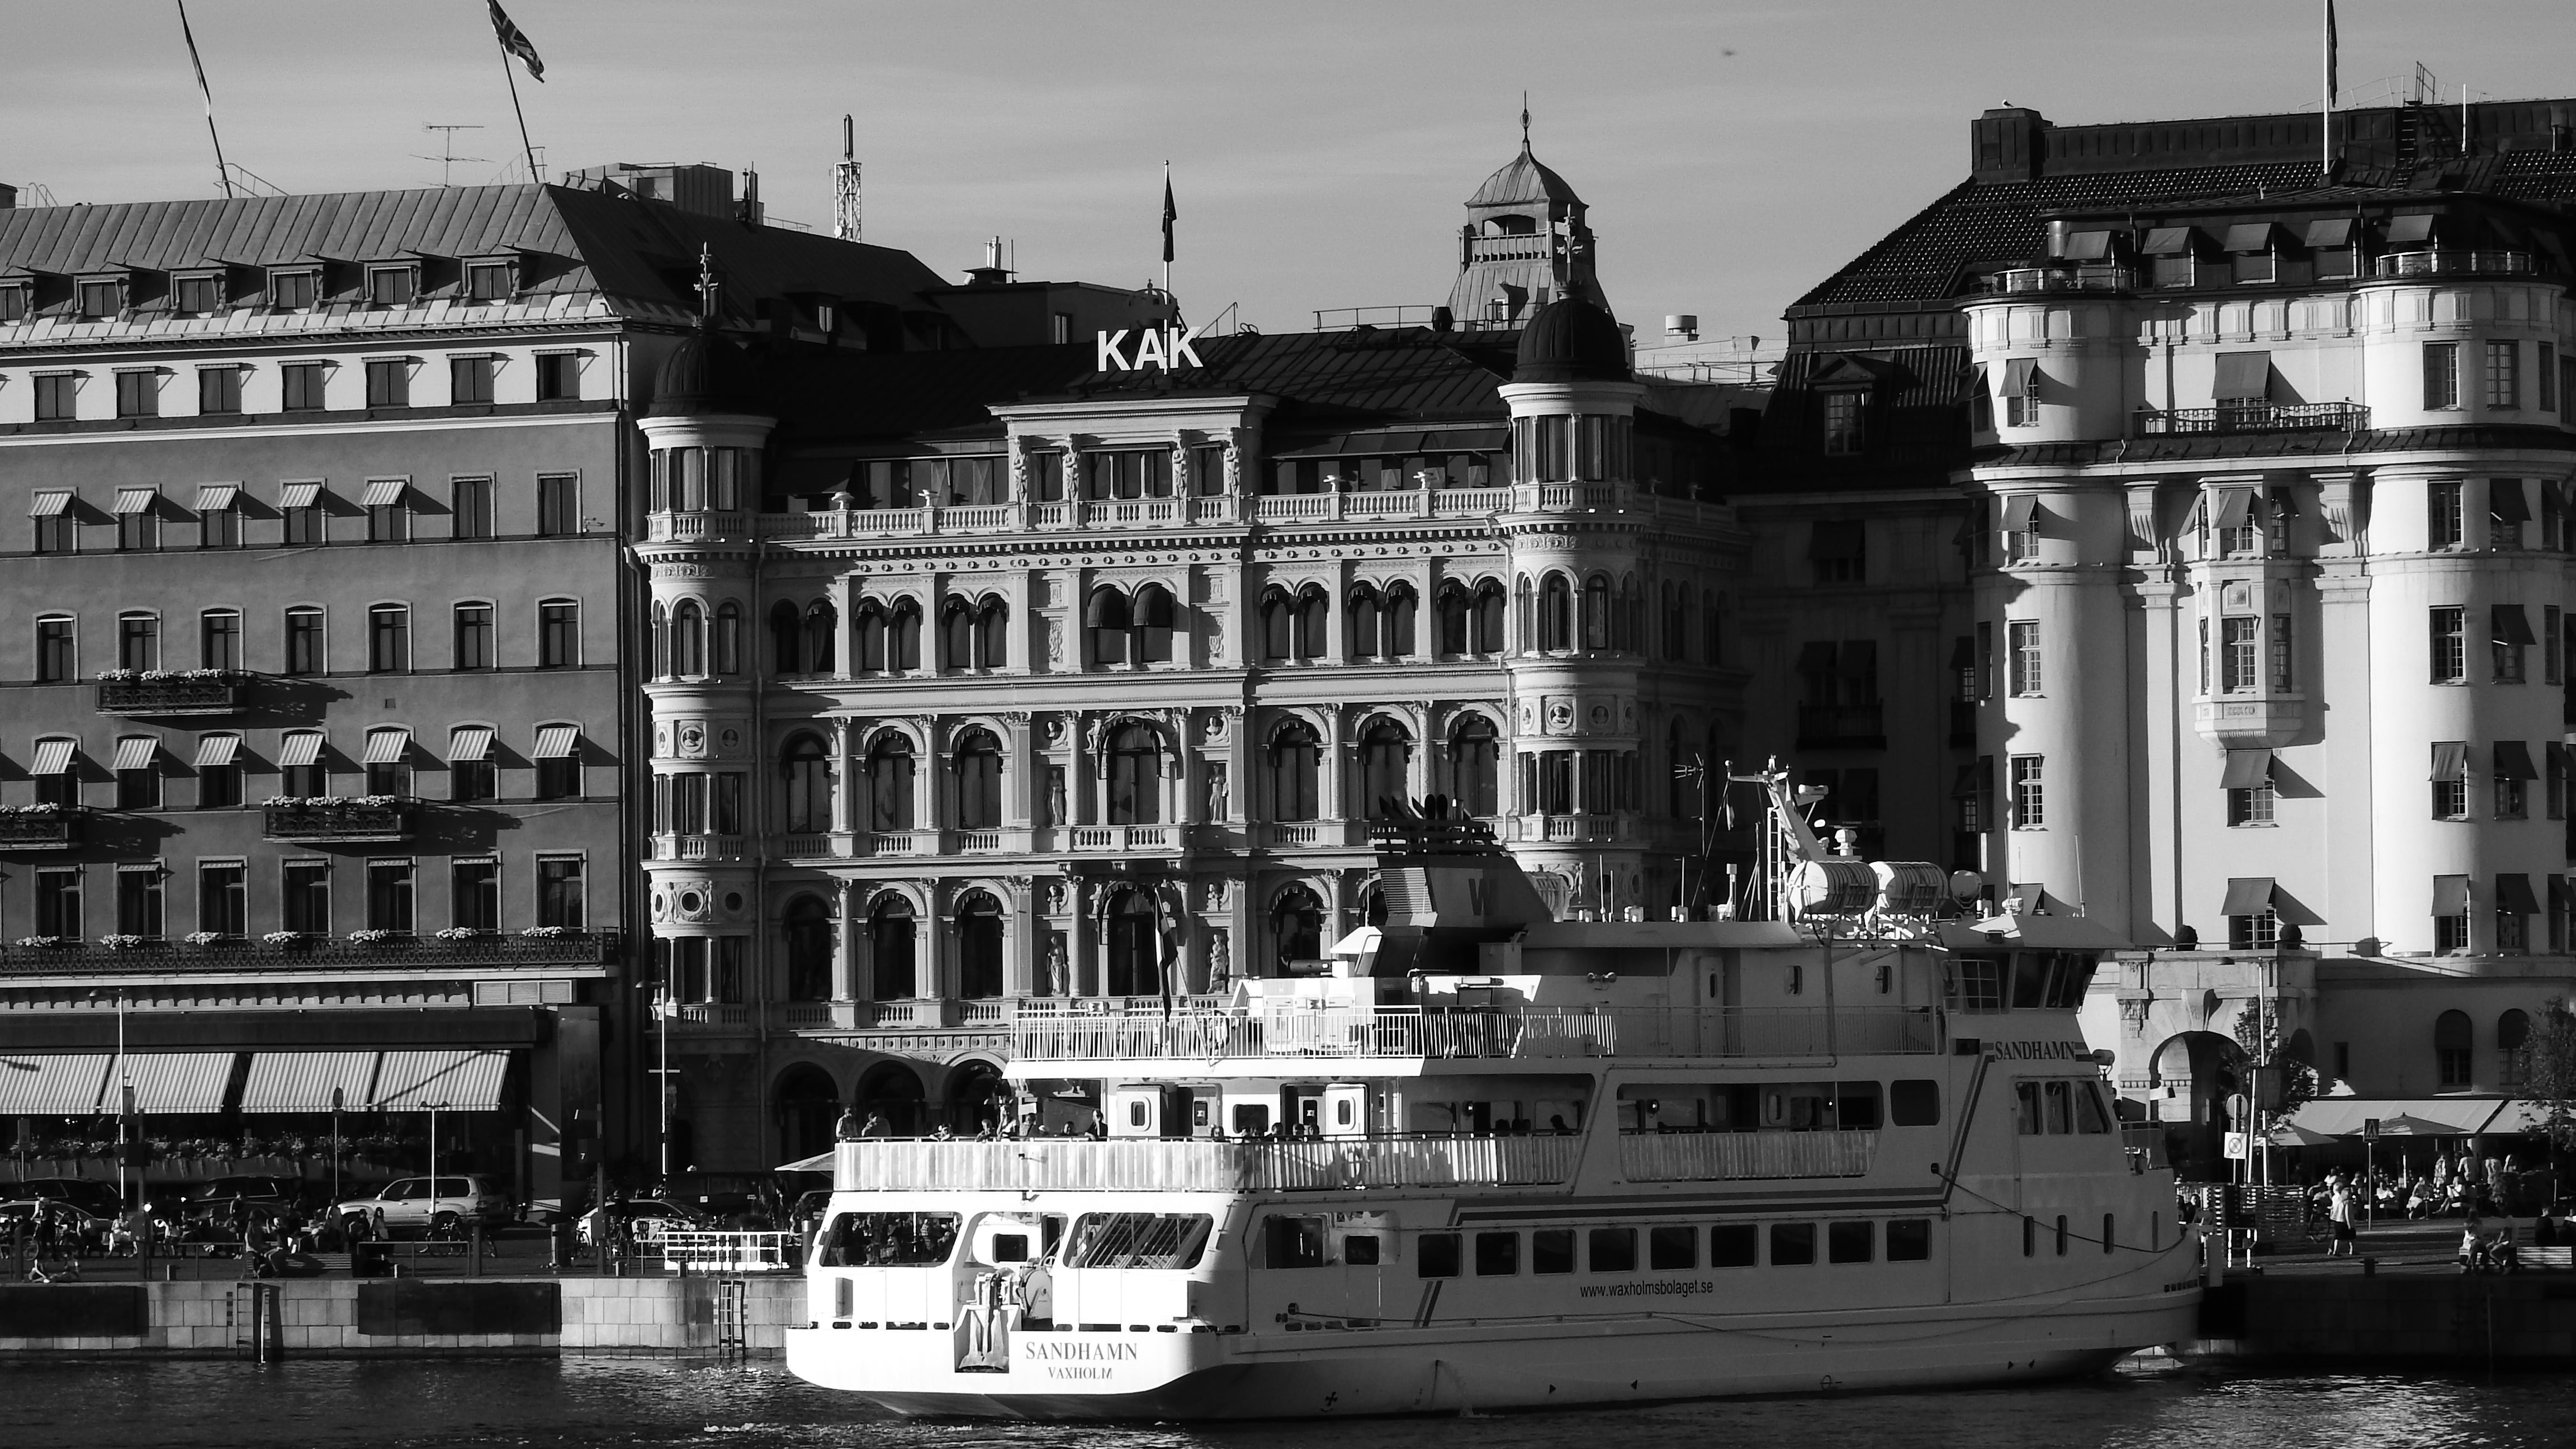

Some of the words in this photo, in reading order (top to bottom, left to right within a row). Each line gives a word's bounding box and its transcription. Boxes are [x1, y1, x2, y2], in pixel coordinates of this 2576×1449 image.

[1097, 326, 1204, 372] KAK
[1995, 1041, 2075, 1060] SANDHAMN
[1580, 1280, 1713, 1298] www.waxholmsbolaget.se
[1026, 1341, 1137, 1360] SANDHAMN
[1048, 1366, 1112, 1380] VAXHOLM
